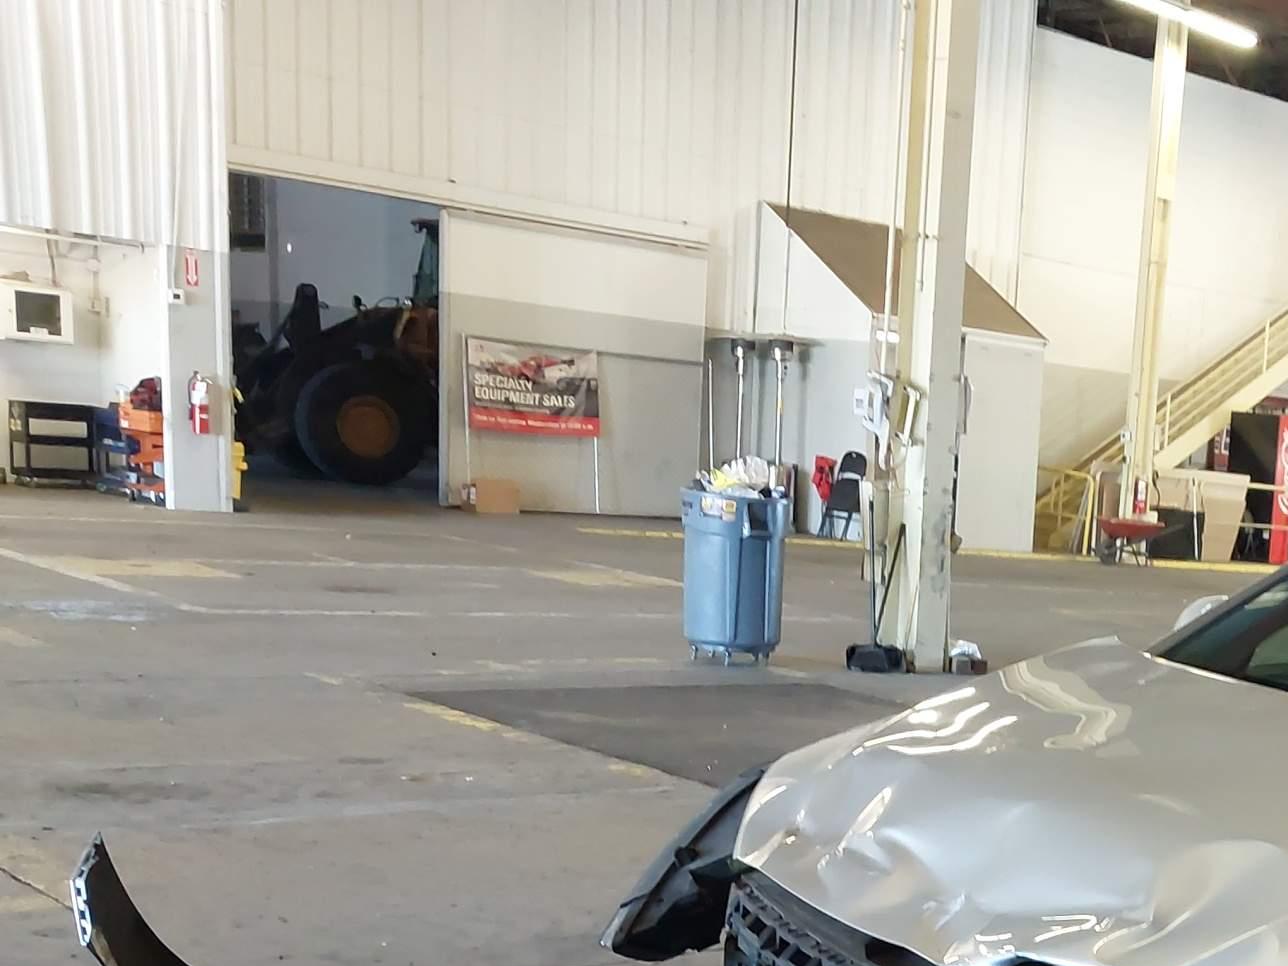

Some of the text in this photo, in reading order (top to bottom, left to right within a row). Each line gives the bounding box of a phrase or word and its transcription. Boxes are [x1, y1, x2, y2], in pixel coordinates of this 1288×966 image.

[474, 373, 533, 392] SPECIALTY
[474, 387, 541, 406] EQUIPMENT
[542, 393, 576, 409] SALES
